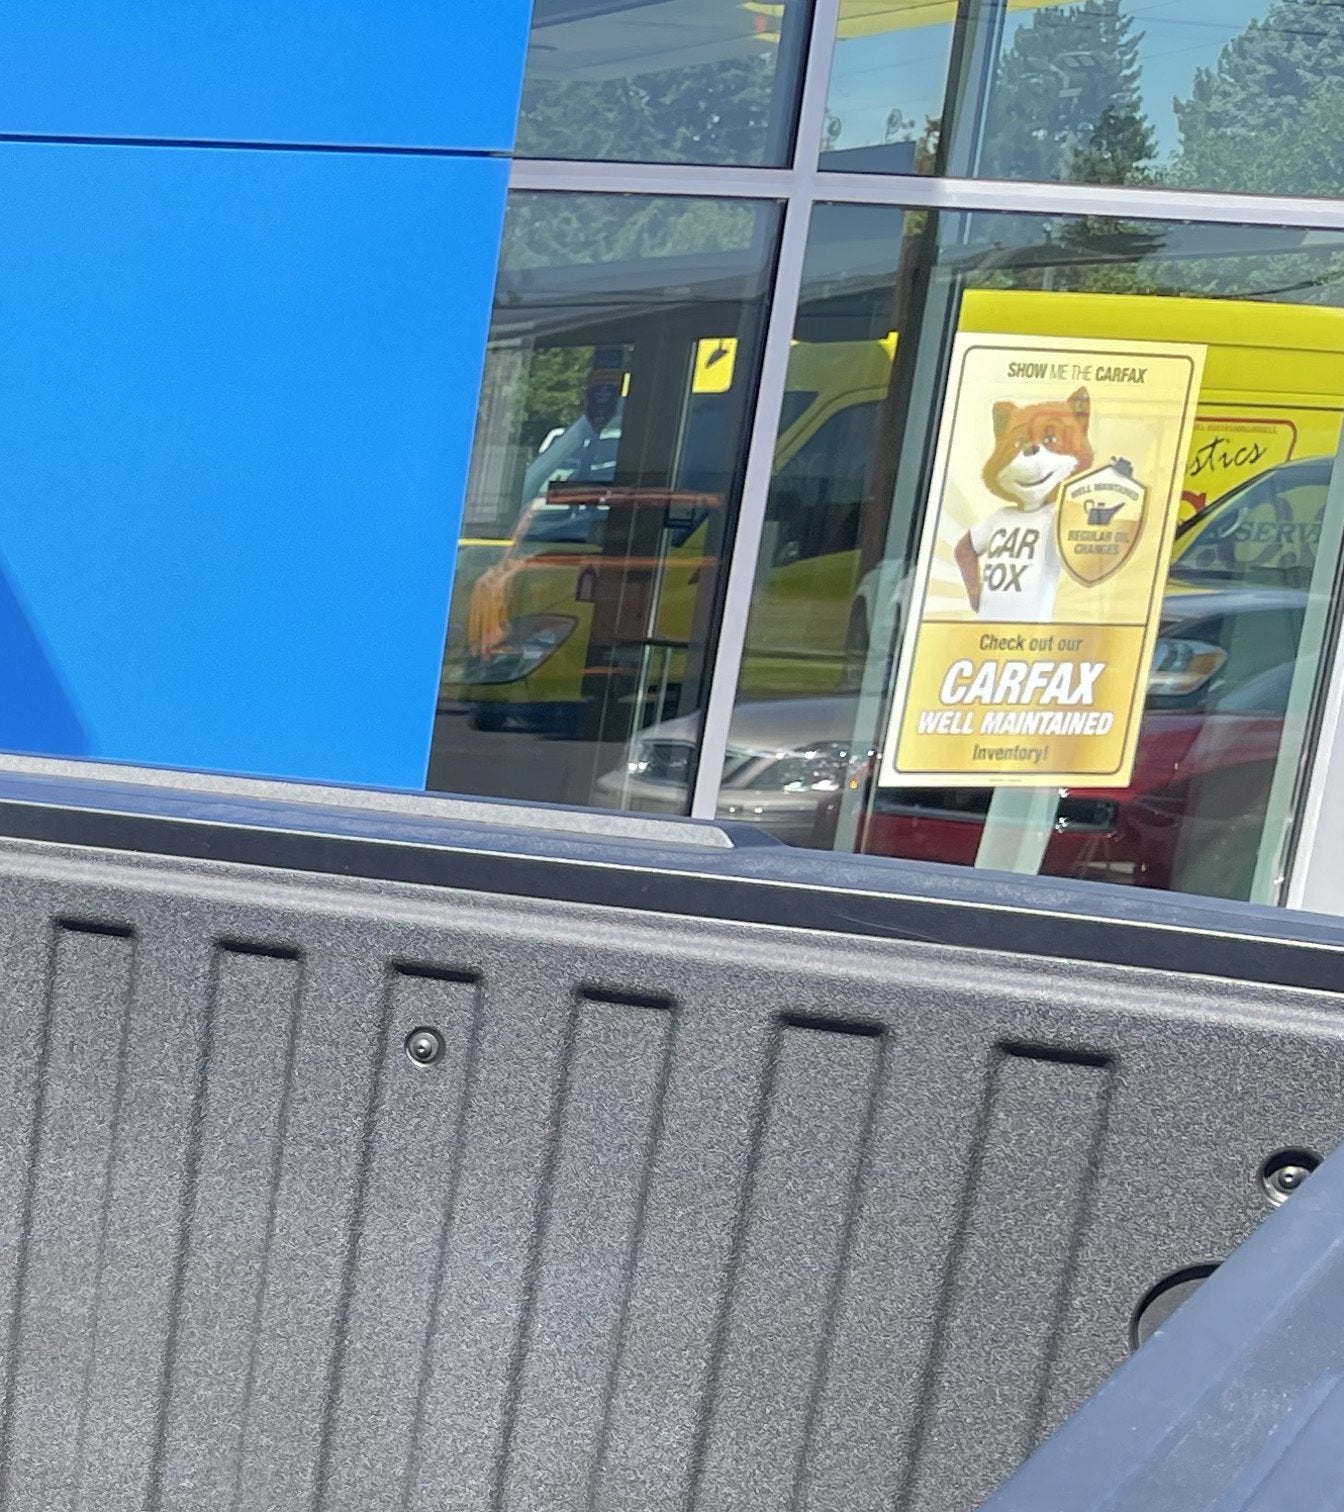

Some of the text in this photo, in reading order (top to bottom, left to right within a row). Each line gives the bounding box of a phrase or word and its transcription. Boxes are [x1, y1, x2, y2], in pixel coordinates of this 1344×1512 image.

[1007, 362, 1148, 383] SHOW ME THE CARFAX
[1184, 436, 1267, 477] stics
[988, 526, 1040, 559] CAR
[979, 634, 1083, 651] Check out our
[939, 658, 1107, 706] CARFAX
[917, 711, 1114, 736] WELL MAINTAINED
[972, 744, 1050, 764] Inventory!
